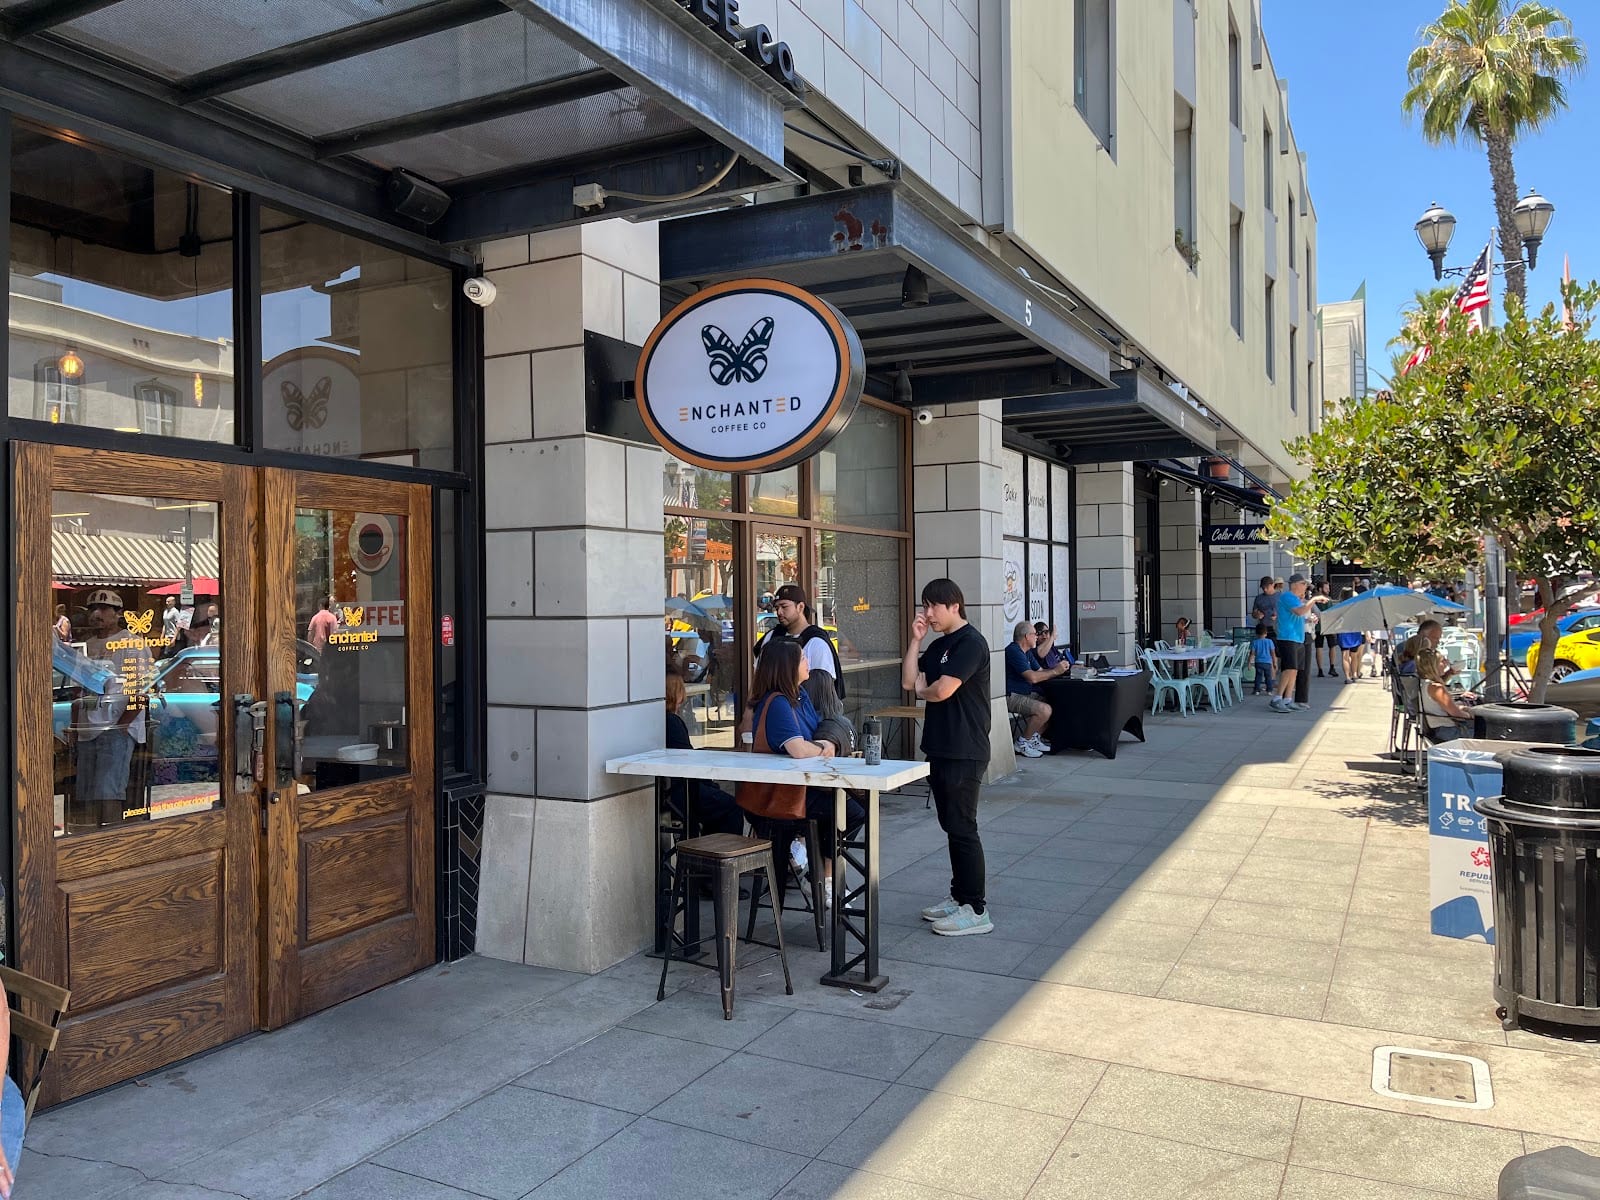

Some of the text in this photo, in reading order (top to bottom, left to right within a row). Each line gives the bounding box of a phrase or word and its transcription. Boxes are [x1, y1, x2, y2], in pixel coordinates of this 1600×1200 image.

[1024, 299, 1033, 327] 5
[679, 396, 802, 422] ENCHANTED
[711, 421, 766, 433] COFFEE CO
[1211, 528, 1233, 542] Color
[1233, 528, 1245, 541] Me
[105, 636, 171, 652] opening hours
[328, 630, 378, 645] enchanted
[122, 807, 147, 820] please
